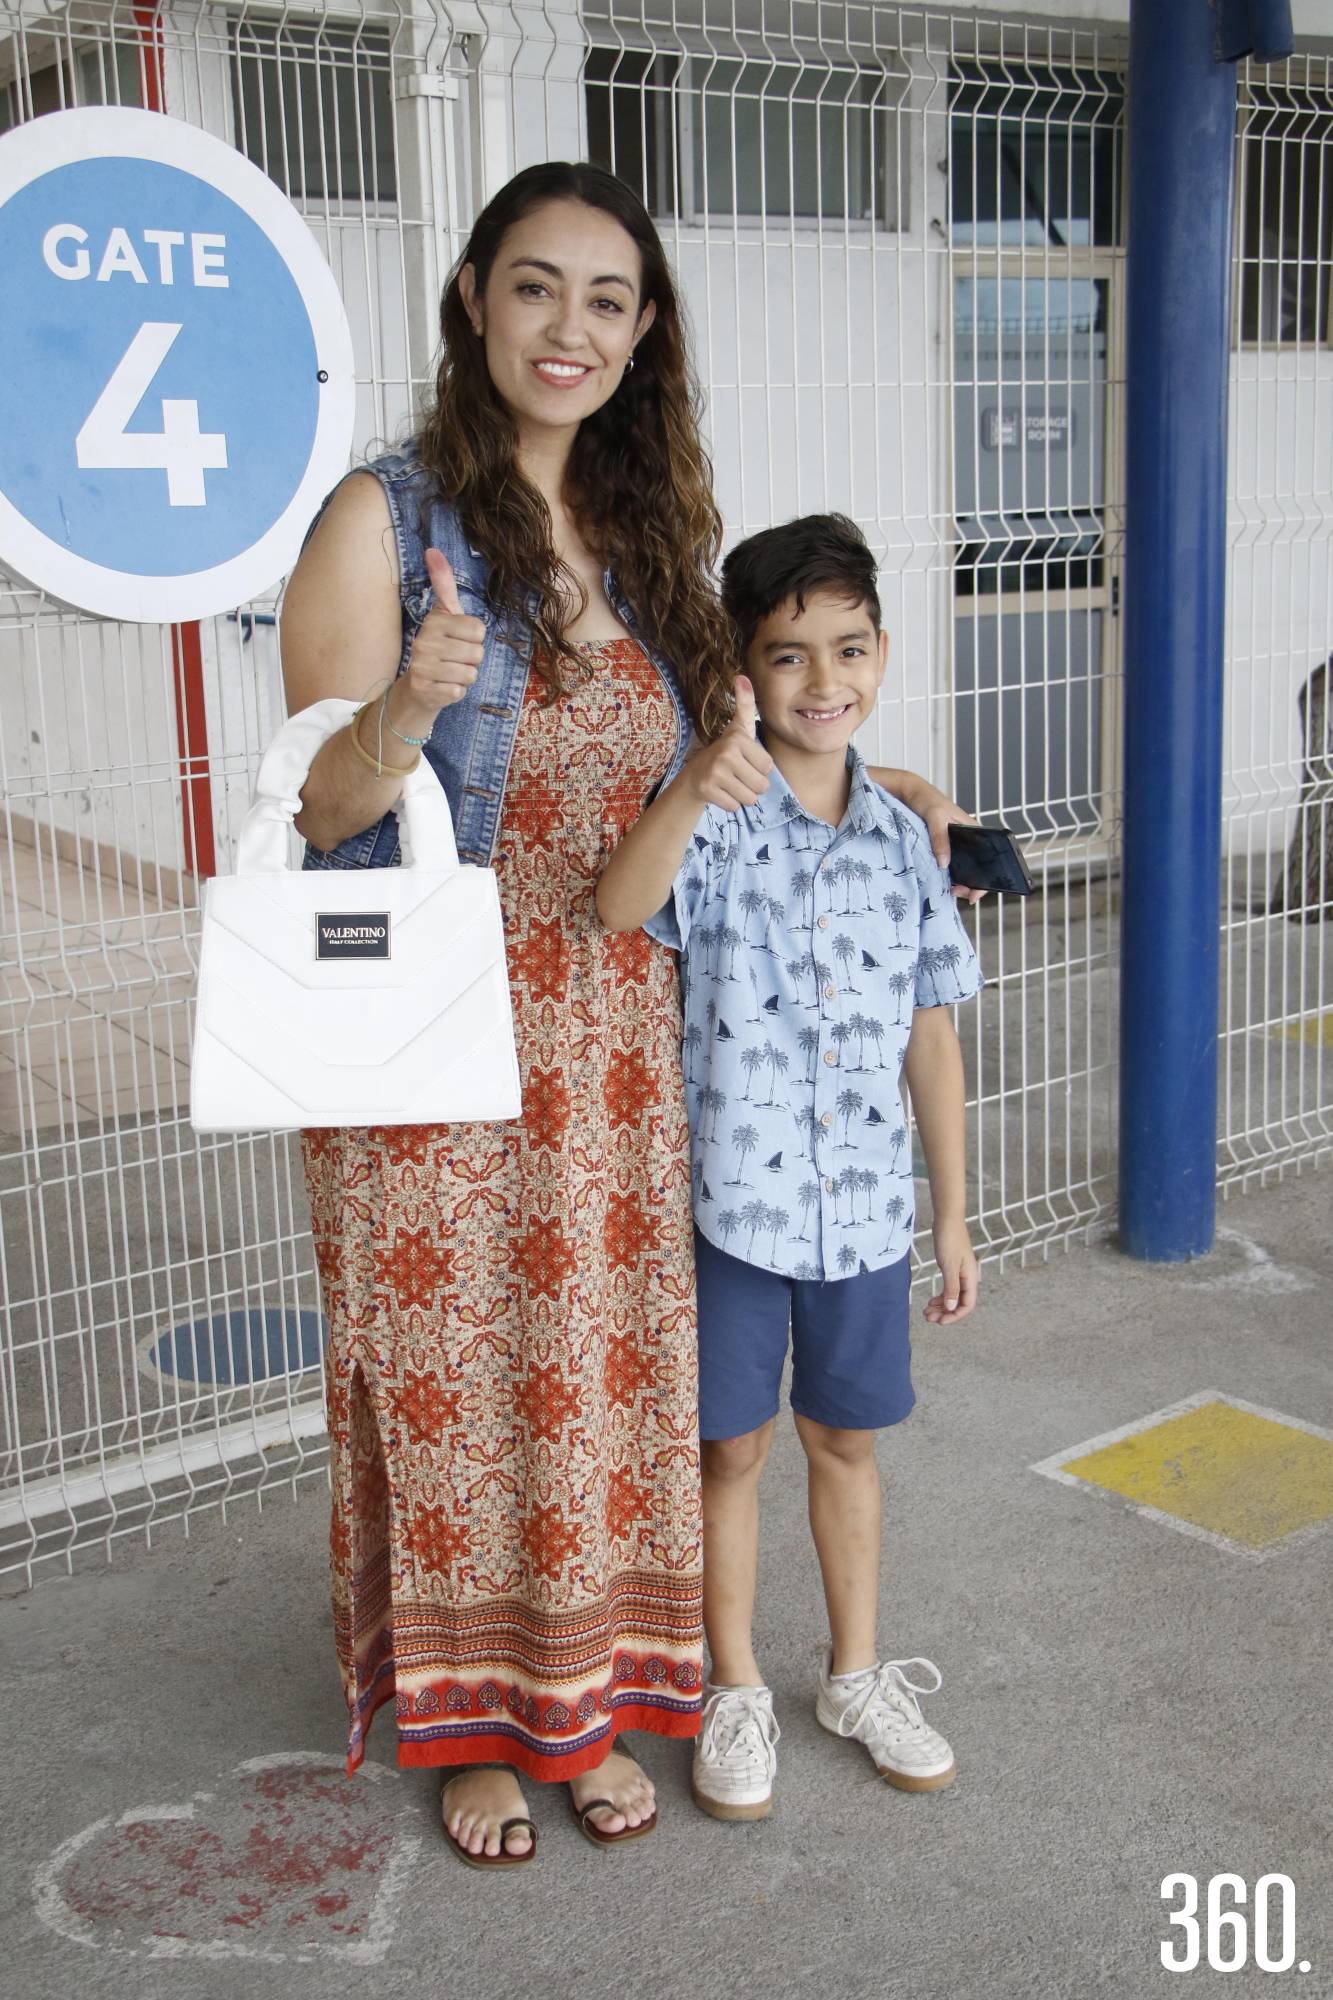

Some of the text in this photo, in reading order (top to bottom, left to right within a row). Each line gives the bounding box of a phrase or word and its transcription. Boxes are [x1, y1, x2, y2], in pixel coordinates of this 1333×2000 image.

[43, 223, 229, 288] GATE
[76, 322, 228, 507] 4
[1021, 417, 1070, 428] TORAGE
[322, 927, 386, 938] VALENTINO
